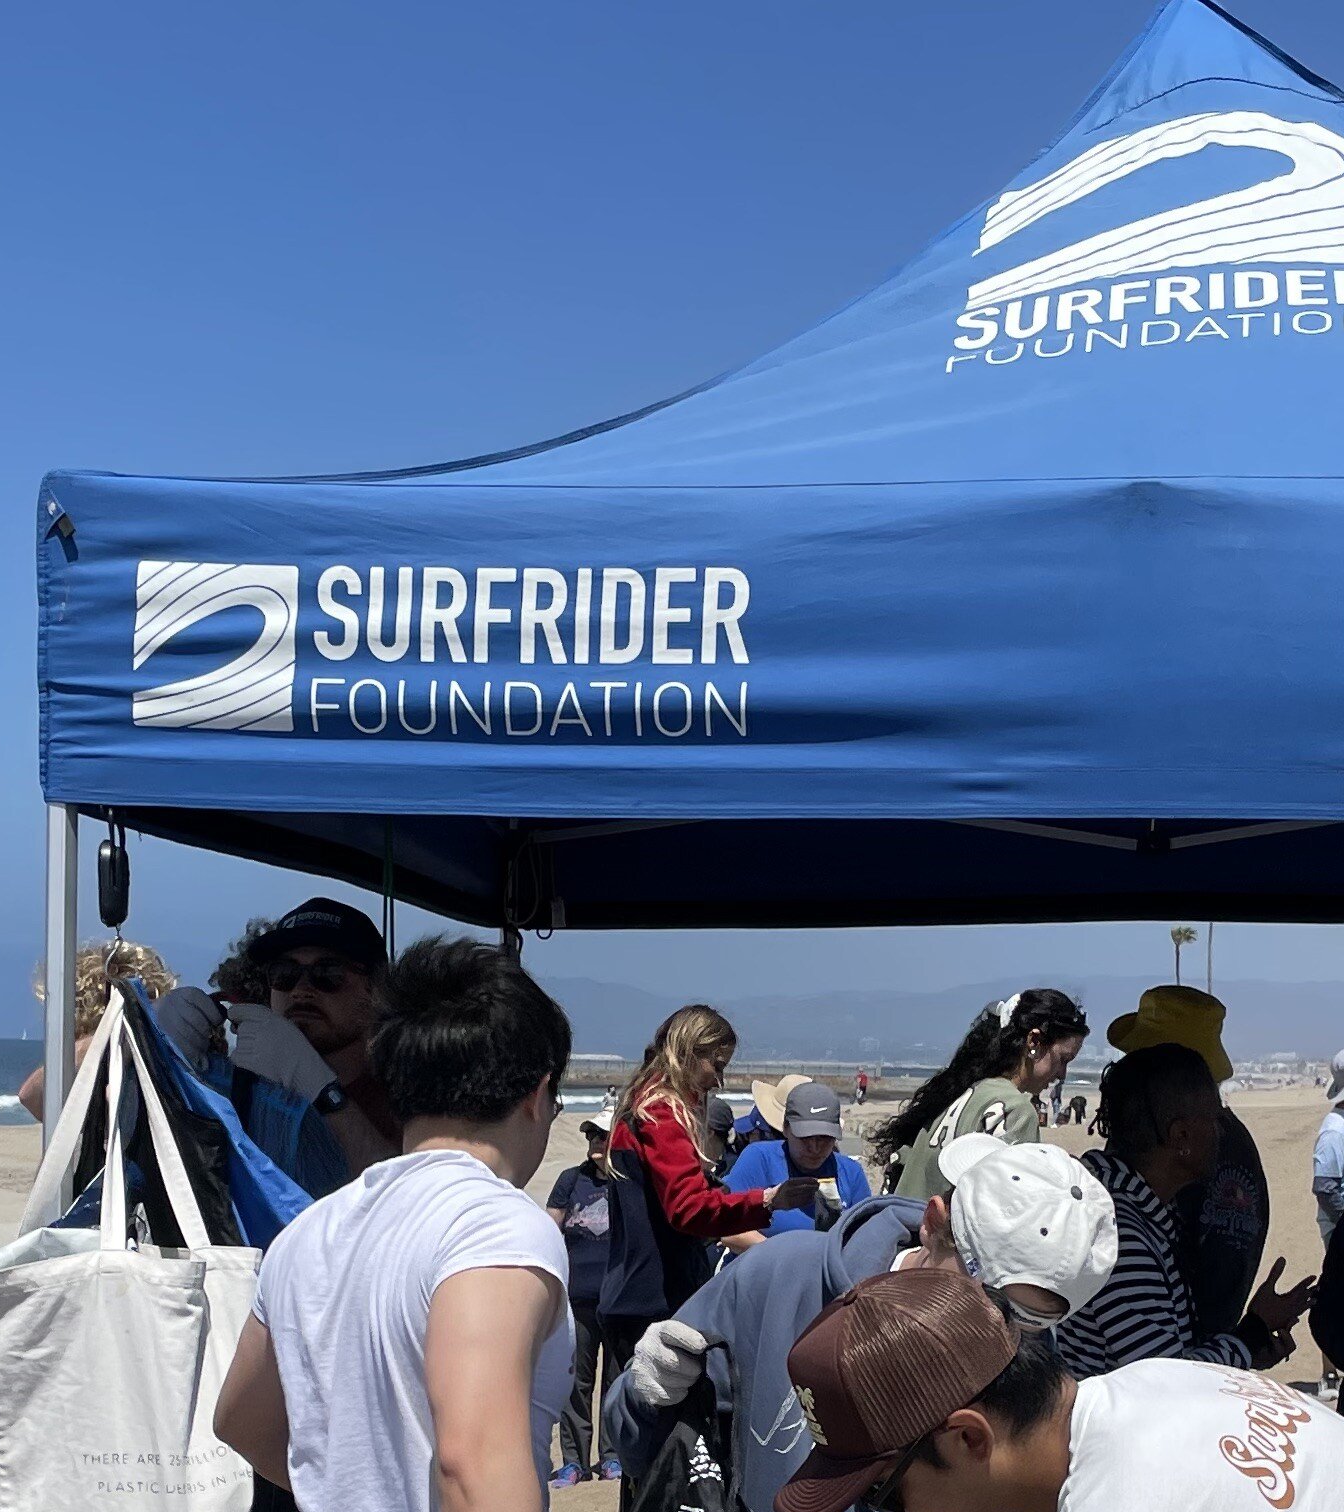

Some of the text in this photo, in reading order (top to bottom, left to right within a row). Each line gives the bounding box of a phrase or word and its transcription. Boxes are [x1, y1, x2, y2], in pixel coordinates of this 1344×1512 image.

[313, 565, 751, 665] SURFRIDER
[309, 677, 748, 737] FOUNDATION
[83, 1453, 160, 1466] THERE ARE
[98, 1481, 159, 1493] PLASTIC
[212, 1476, 226, 1489] IN
